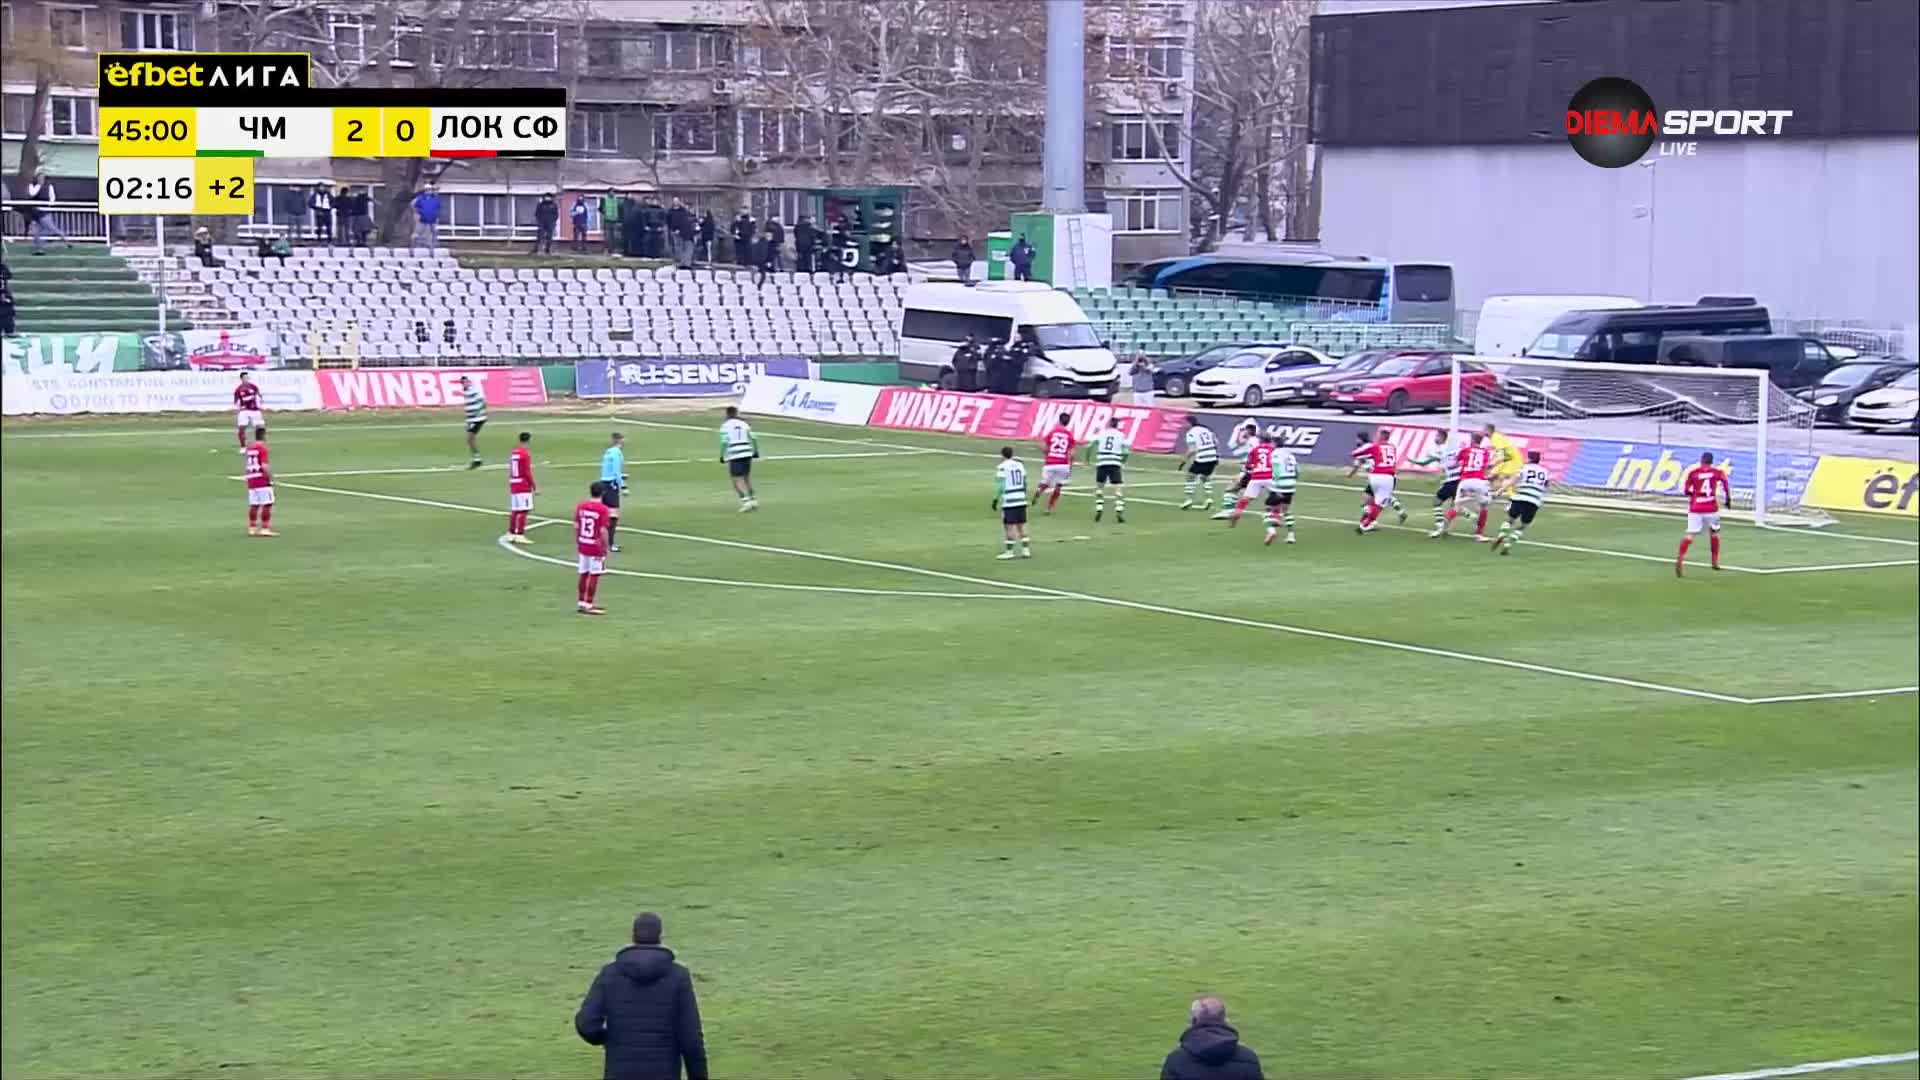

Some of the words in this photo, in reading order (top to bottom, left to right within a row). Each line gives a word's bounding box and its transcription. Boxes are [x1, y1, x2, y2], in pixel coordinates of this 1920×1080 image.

[884, 392, 993, 434] WINBET
[1050, 437, 1069, 453] 29
[1104, 436, 1114, 451] 6
[1010, 468, 1023, 486] 10
[1527, 469, 1546, 486] 29
[1700, 479, 1712, 497] 4
[580, 517, 595, 538] 13
